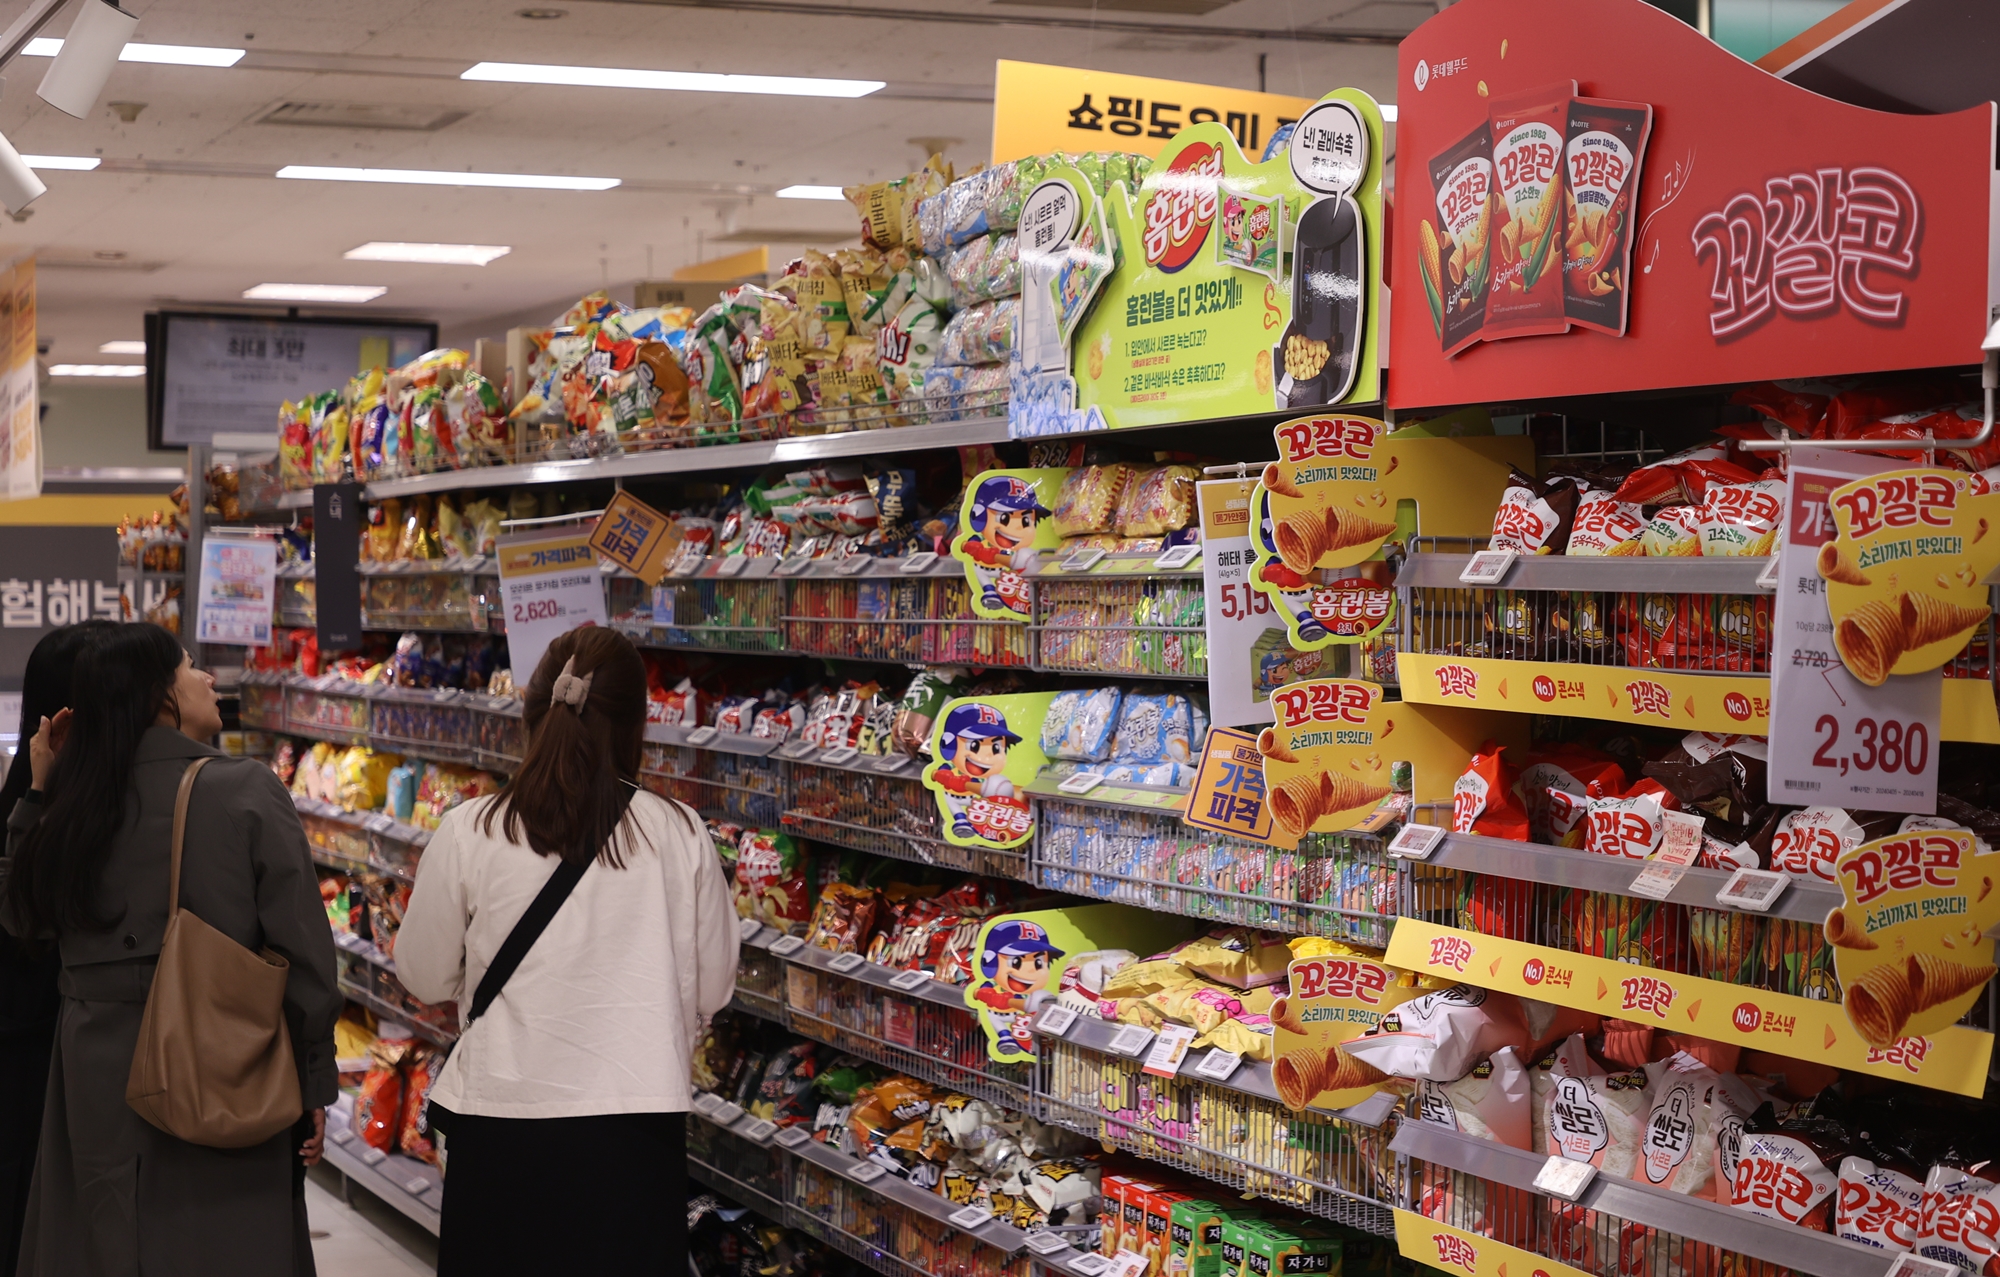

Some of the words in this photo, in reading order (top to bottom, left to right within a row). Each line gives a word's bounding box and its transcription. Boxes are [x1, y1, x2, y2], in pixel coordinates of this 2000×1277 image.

[1432, 57, 1468, 80] 롯데웰푸드
[1316, 129, 1354, 157] 겉바속촉
[1509, 131, 1529, 146] Since
[1530, 129, 1547, 140] 1983
[1582, 138, 1601, 147] Since
[1602, 138, 1618, 152] 1983
[1499, 143, 1555, 191] 꼬깔콘
[1570, 150, 1624, 194] 꼬깔콘
[1441, 172, 1486, 227] 꼬깔콘
[1514, 186, 1540, 204] 고소한맛
[1034, 202, 1052, 227] 사르르
[1249, 208, 1270, 232] 홈런볼
[1692, 167, 1918, 336] 꼬깔콘
[1126, 289, 1175, 328] 홈런볼을
[1177, 285, 1191, 317] 더
[1194, 276, 1243, 316] 맛있게!!
[1125, 342, 1130, 357] 1.
[1131, 337, 1156, 357] 입안에서
[1156, 334, 1176, 352] 사르르
[1177, 329, 1207, 349] 녹는다고?
[1144, 370, 1171, 390] 바삭바삭
[1172, 368, 1185, 386] 속은
[1186, 362, 1226, 384] 촉촉하다고?
[1279, 420, 1376, 463] 꼬깔콘
[1294, 465, 1338, 486] 소리까지
[1341, 466, 1377, 482] 맛있다!
[1571, 500, 1643, 544] 꼬깔콘
[1835, 477, 1956, 540] 꼬깔콘
[611, 514, 650, 547] 가격
[1707, 528, 1747, 545] 고소한맛
[531, 546, 592, 567] 가격파격
[601, 531, 639, 563] 파격
[1218, 550, 1241, 567] 해태
[1858, 540, 1913, 570] 소리까지
[1916, 537, 1963, 555] 맛있다!
[1798, 577, 1818, 595] 롯데
[514, 599, 557, 624] 2,620
[1311, 589, 1392, 618] 홈런볼
[1796, 621, 1815, 632] 10g당
[1793, 649, 1828, 668] 2,720
[1436, 665, 1478, 699] 꼬깔콘
[1534, 681, 1555, 698] No.1
[1557, 680, 1585, 701] 콘스낵
[1275, 684, 1372, 728] 꼬깔콘
[1626, 680, 1671, 719] 꼬깔콘
[1727, 699, 1749, 716] No.1
[1289, 731, 1333, 750] 소리까지
[1336, 730, 1373, 745] 맛있다!
[1812, 713, 1929, 777] 2,380
[1215, 762, 1266, 800] 가격
[967, 799, 1033, 832] 홈런볼
[1207, 792, 1262, 830] 파격
[1840, 837, 1961, 904] 꼬깔콘
[1865, 904, 1919, 934] 소리까지
[1921, 897, 1968, 919] 맛있다!
[1428, 936, 1473, 973] 꼬깔콘
[1293, 960, 1388, 1004] 꼬깔콘
[1524, 962, 1544, 982] No.1
[1544, 965, 1574, 989] 콘스낵
[1621, 977, 1674, 1018] 꼬깔콘
[1301, 1005, 1345, 1023] 소리까지
[1735, 1008, 1759, 1028] No.1
[1762, 1011, 1797, 1037] 콘스낵
[1563, 1085, 1577, 1104] 더
[1670, 1097, 1682, 1117] 더
[1555, 1101, 1598, 1137] 쌀로
[1652, 1113, 1687, 1152] 쌀로
[1562, 1134, 1592, 1155] 사르르
[1649, 1149, 1672, 1170] 사르르
[1731, 1157, 1814, 1223] 꼬깔콘
[1917, 1190, 2000, 1256] 꼬깔콘
[1222, 1243, 1243, 1262] 자가비
[1249, 1253, 1269, 1273] 자가비
[1287, 1255, 1329, 1269] 자가비
[1432, 1233, 1476, 1275] 꼬깔콘
